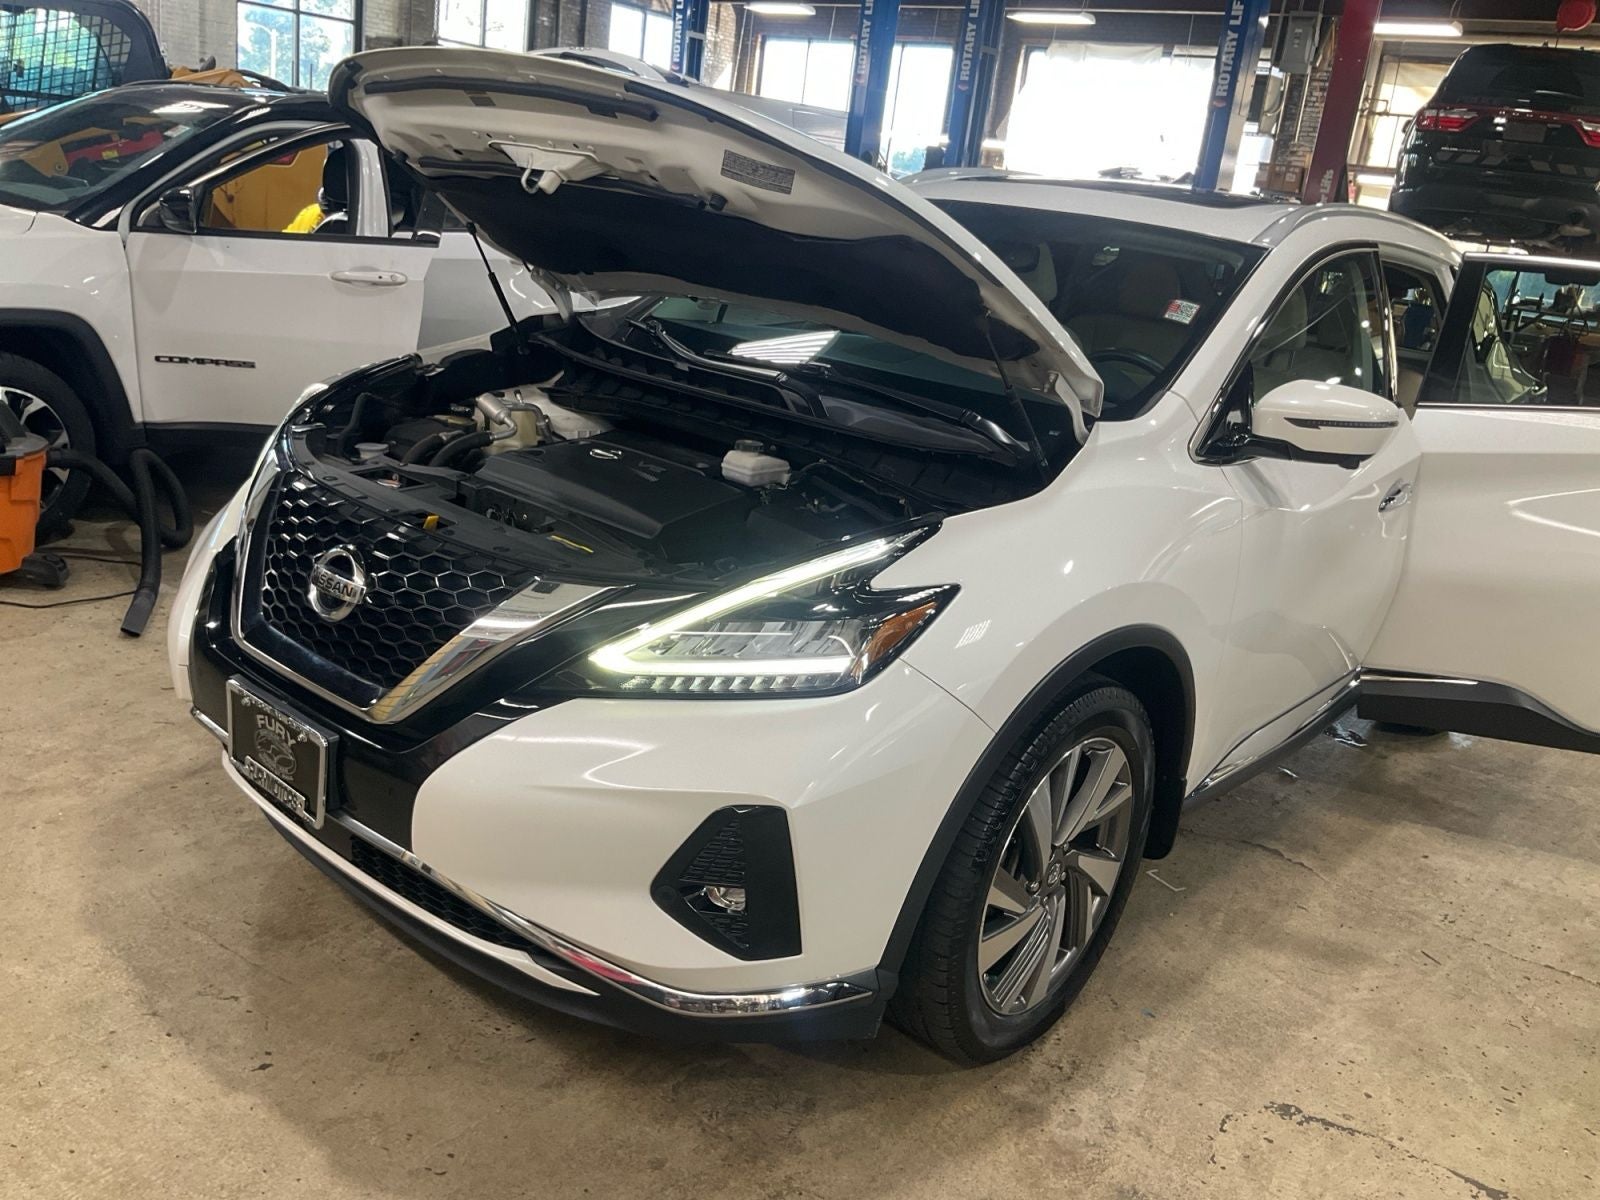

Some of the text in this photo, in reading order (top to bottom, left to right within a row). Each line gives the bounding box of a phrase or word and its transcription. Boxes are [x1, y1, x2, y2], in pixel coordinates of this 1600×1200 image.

[672, 12, 683, 62] ROTARY
[857, 19, 872, 74] ROTARY
[960, 22, 977, 80] ROTARY
[1216, 30, 1239, 96] ROTARY
[155, 355, 256, 369] COMPASS
[256, 714, 296, 746] FURY
